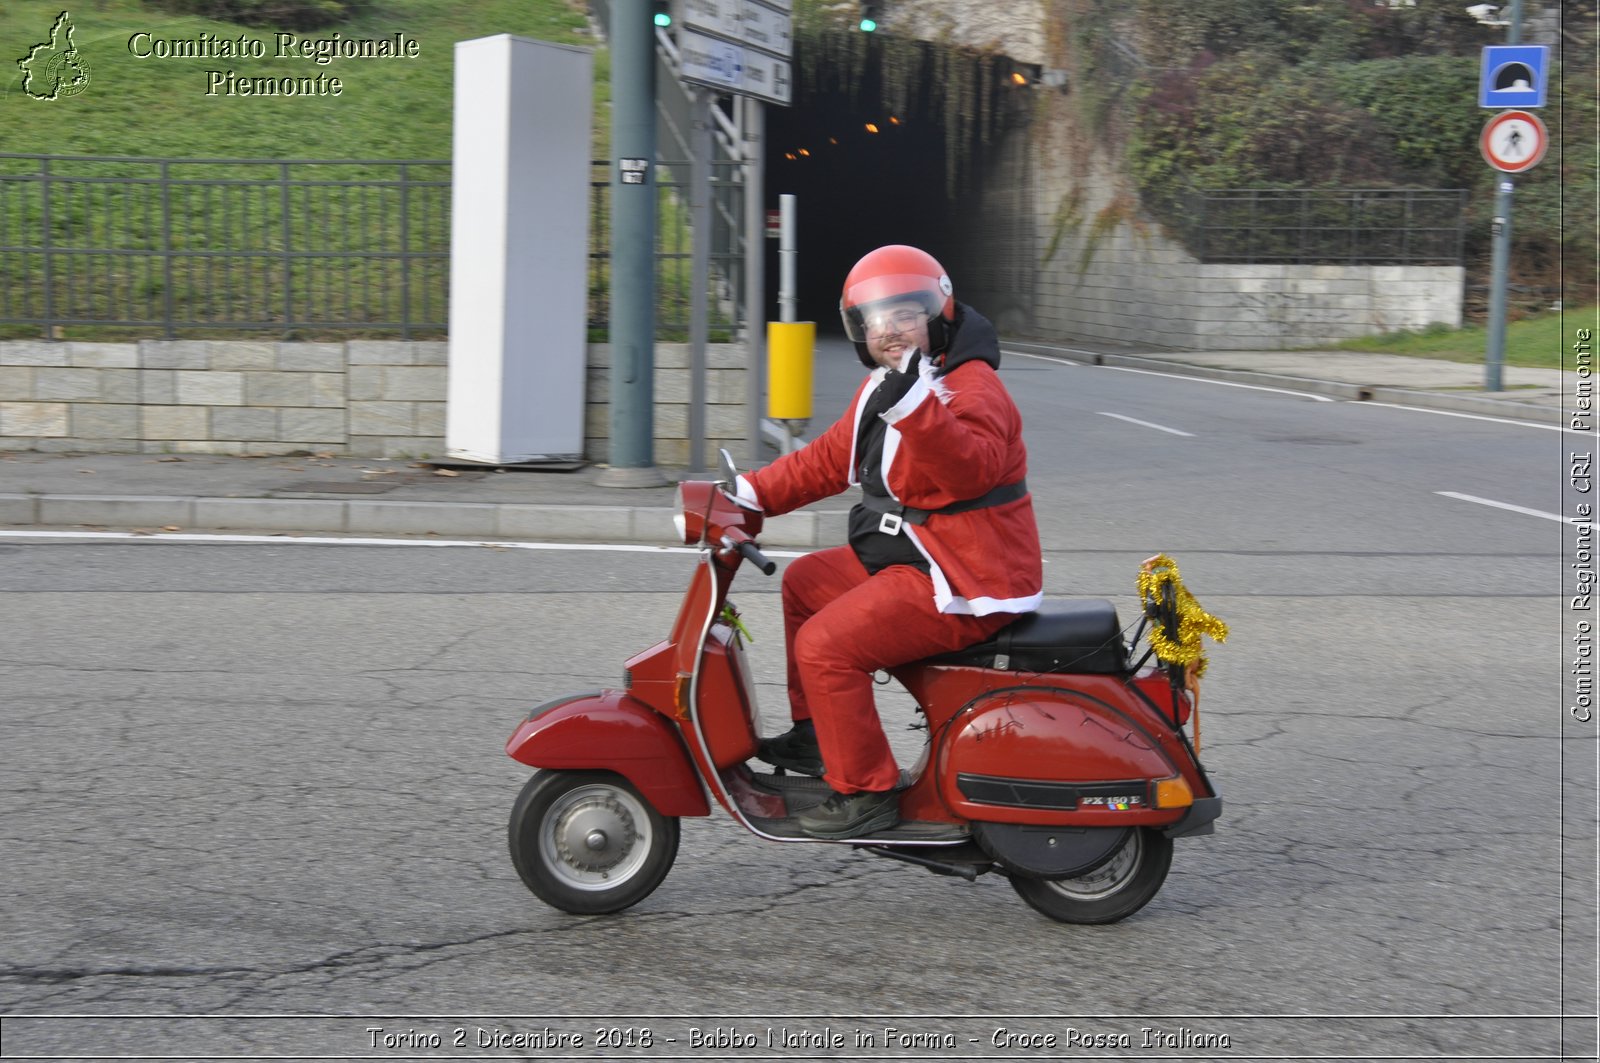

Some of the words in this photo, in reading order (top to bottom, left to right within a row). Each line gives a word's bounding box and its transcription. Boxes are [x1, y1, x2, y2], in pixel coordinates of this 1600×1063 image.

[1082, 796, 1104, 805] PX
[1106, 796, 1128, 805] 150
[1130, 795, 1141, 804] E
